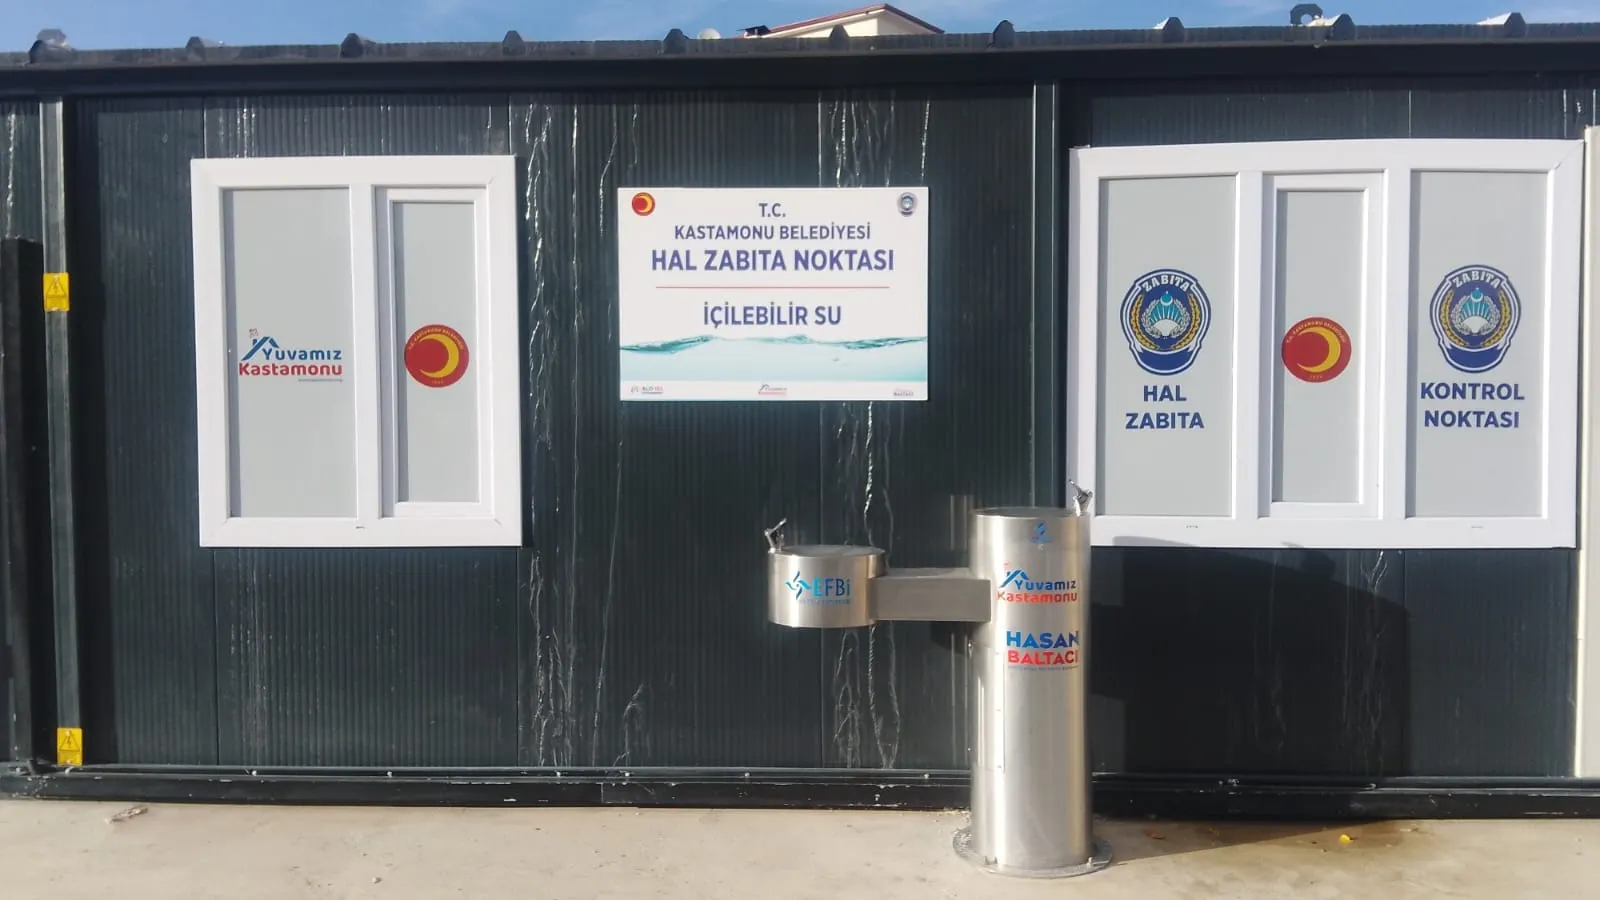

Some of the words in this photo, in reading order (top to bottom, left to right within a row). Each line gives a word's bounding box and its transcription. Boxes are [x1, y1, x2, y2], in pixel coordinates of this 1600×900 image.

[758, 203, 786, 217] T.C.
[674, 225, 774, 240] KASTAMONU
[779, 221, 871, 240] BELEDİYESİ
[651, 250, 697, 271] HAL
[704, 250, 787, 271] ZABITA
[793, 250, 894, 271] NOKTASI
[703, 301, 808, 328] İÇİLEBİLİR
[814, 305, 841, 325] SU
[262, 348, 342, 361] Yuvamız
[239, 363, 343, 376] Kastamonu
[1143, 385, 1187, 402] HAL
[1420, 382, 1525, 400] KONTROL
[1125, 412, 1204, 429] ZABITA
[1424, 410, 1519, 428] NOKTASI
[1014, 579, 1077, 591] Yuvamız
[997, 591, 1078, 604] Kastamonu
[1006, 631, 1080, 649] HASAN
